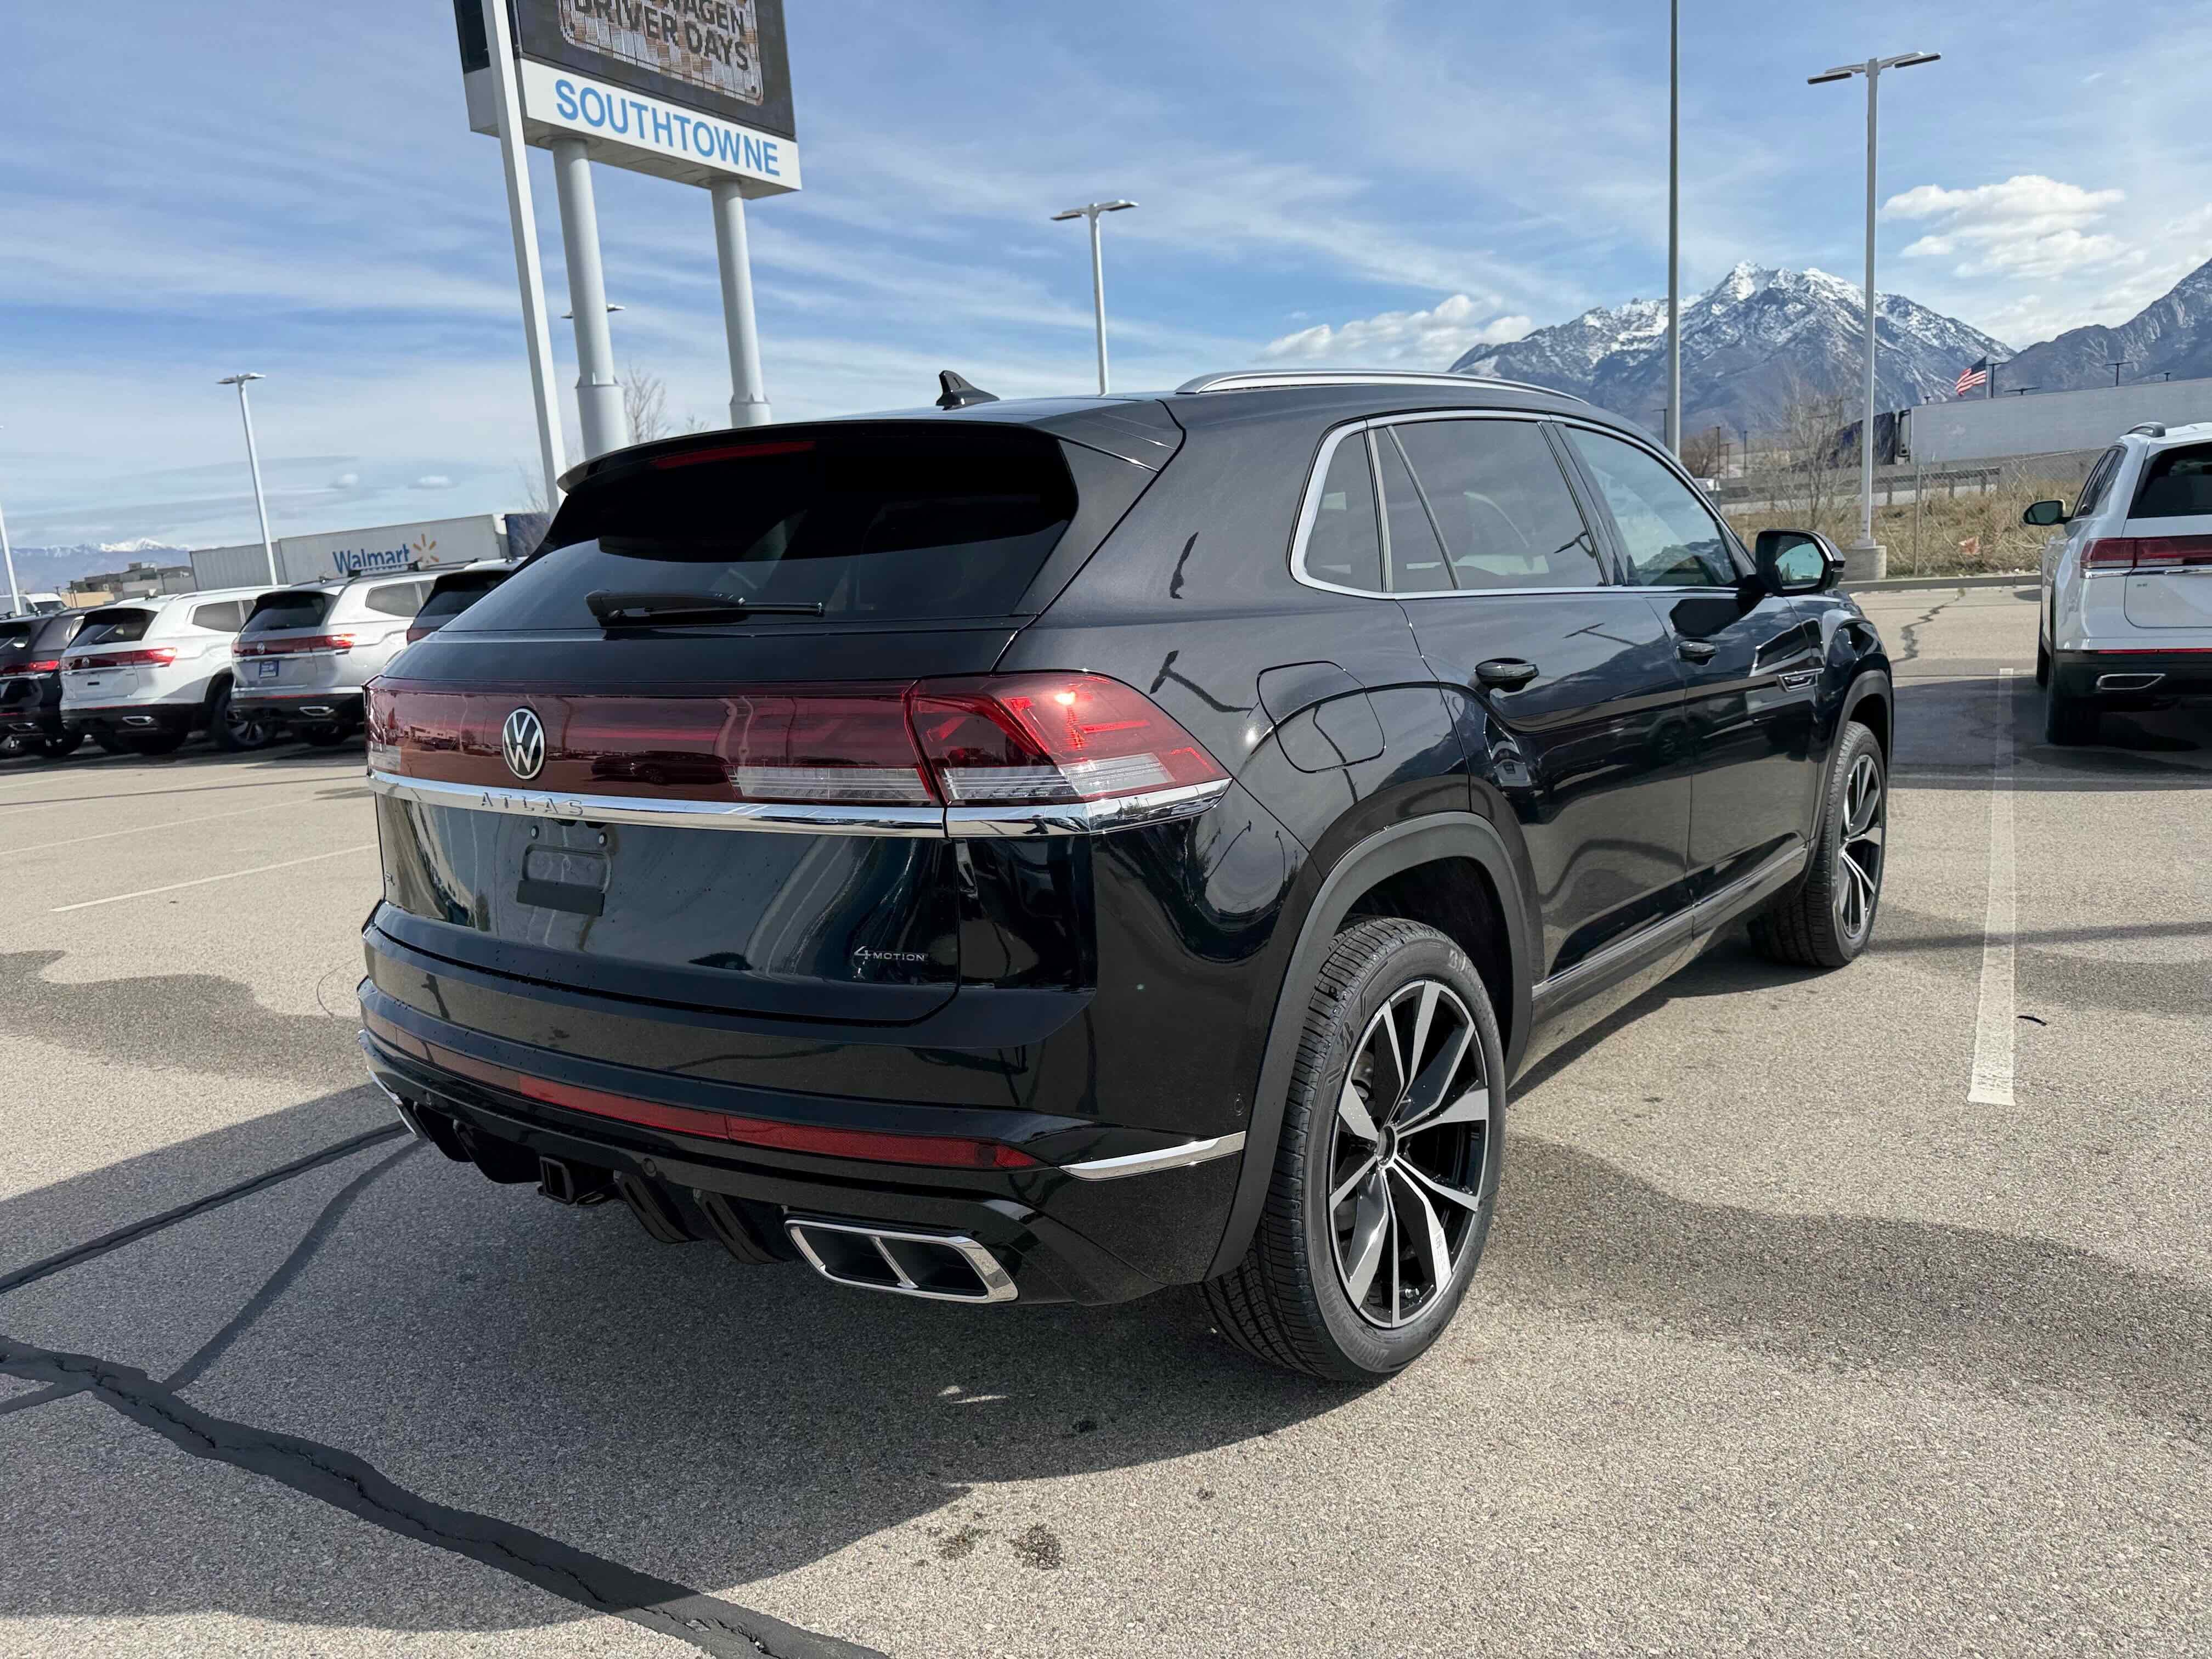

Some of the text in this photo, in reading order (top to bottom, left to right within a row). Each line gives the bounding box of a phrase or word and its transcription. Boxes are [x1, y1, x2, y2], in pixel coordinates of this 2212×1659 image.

[685, 21, 748, 71] DAYS
[555, 79, 780, 176] SOUTHTOWNE
[332, 544, 410, 574] Walmart
[481, 792, 584, 816] ATLAS
